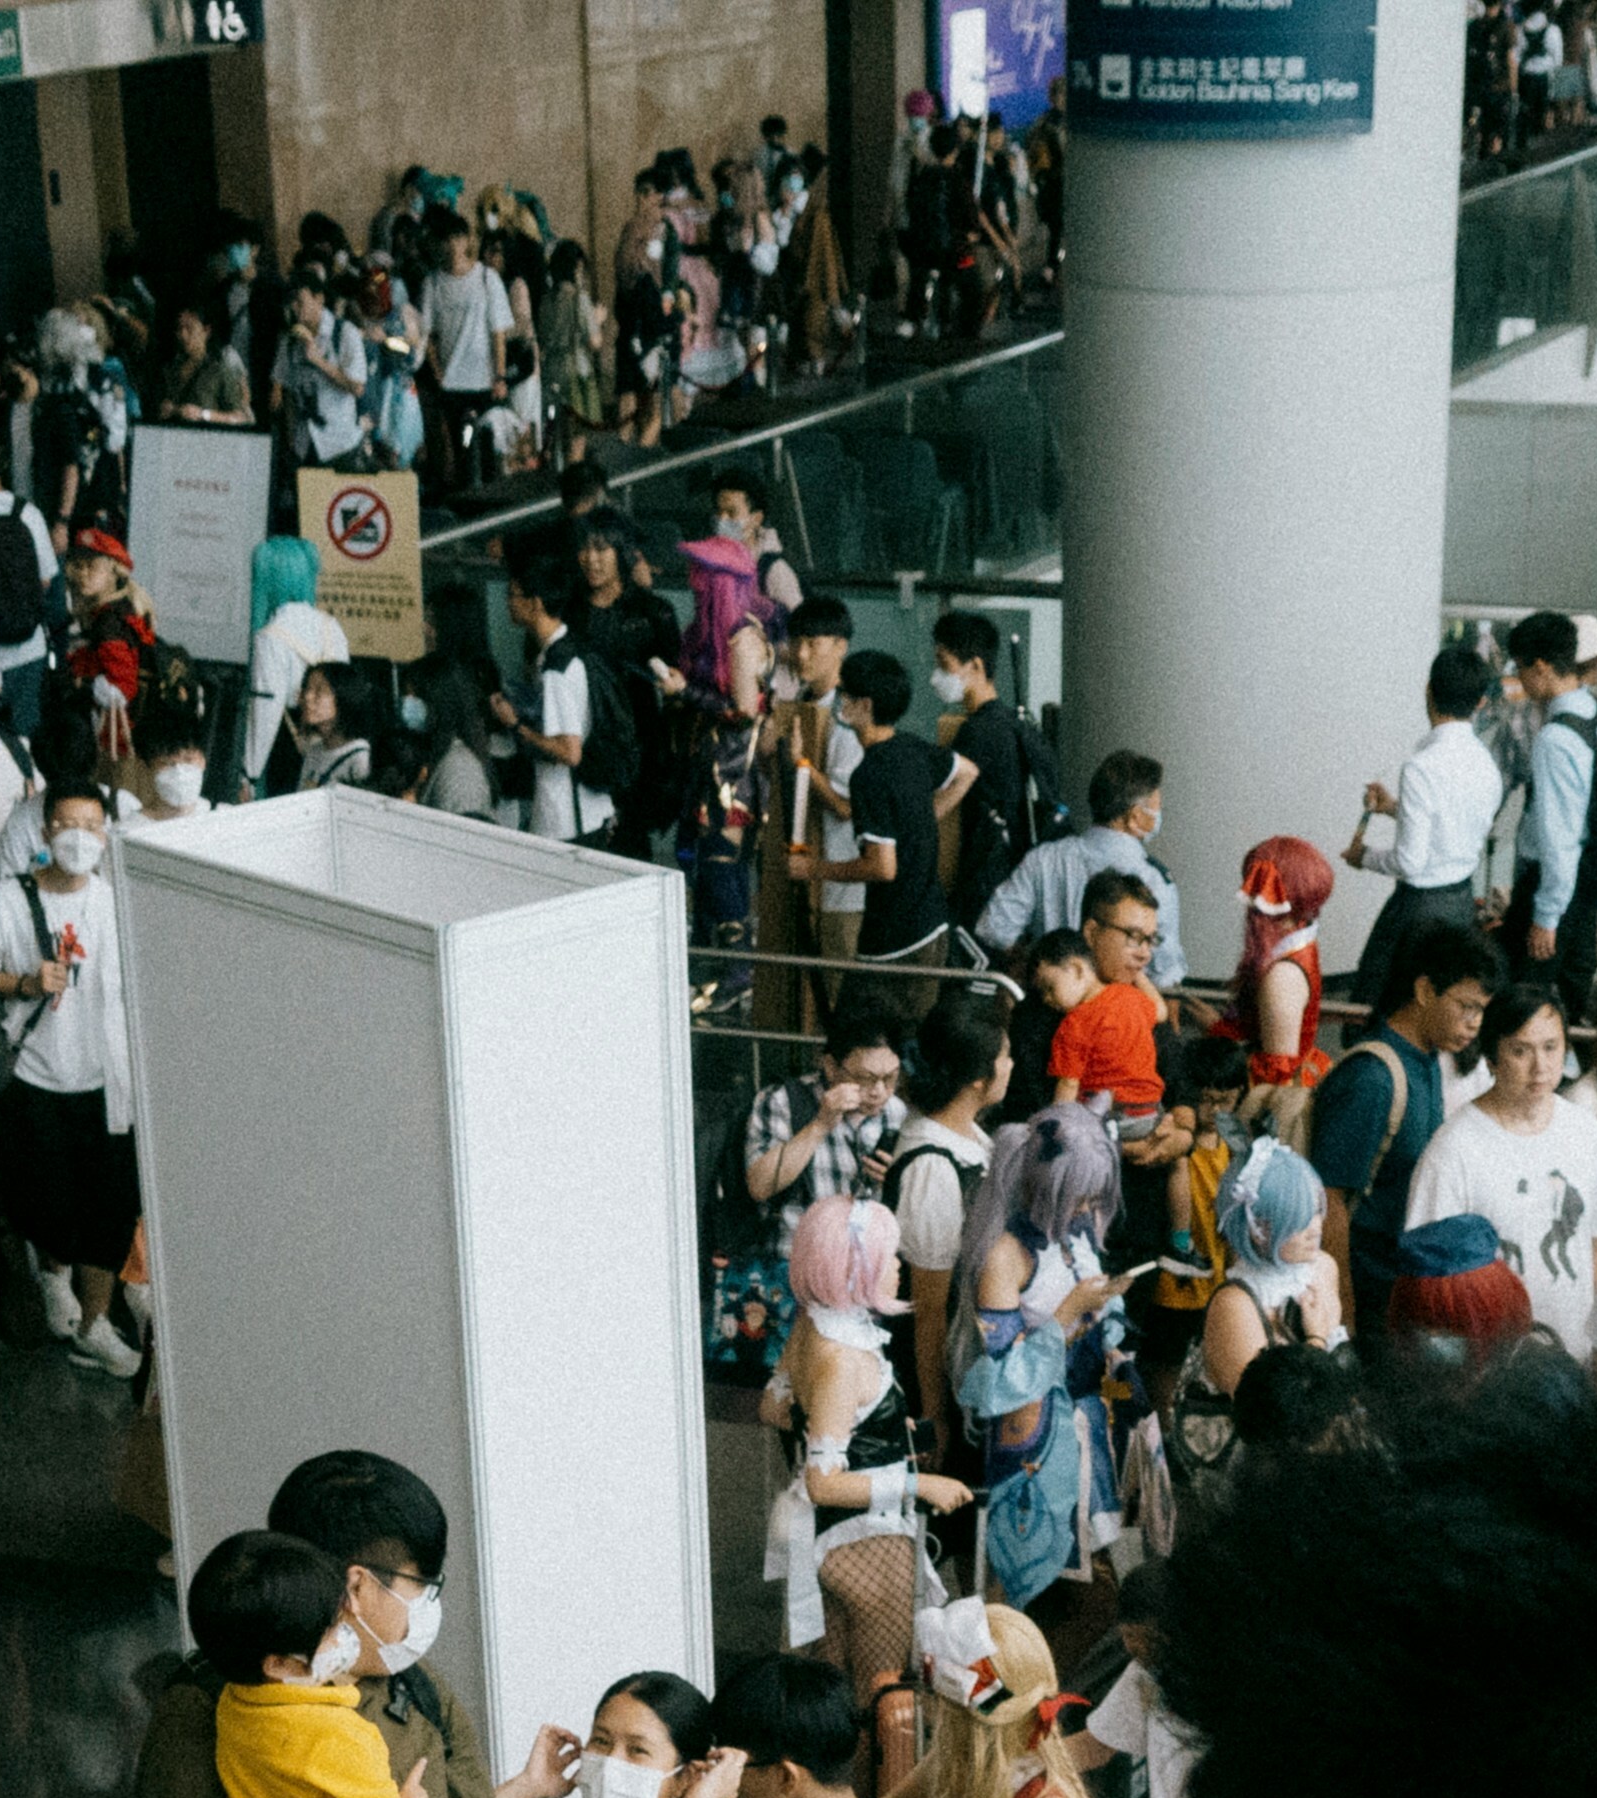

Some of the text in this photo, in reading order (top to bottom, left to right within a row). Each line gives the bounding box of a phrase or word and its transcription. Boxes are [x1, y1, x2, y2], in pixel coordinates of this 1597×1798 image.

[1138, 79, 1196, 101] Golden
[1273, 80, 1321, 106] Sang
[1322, 78, 1359, 100] Kee
